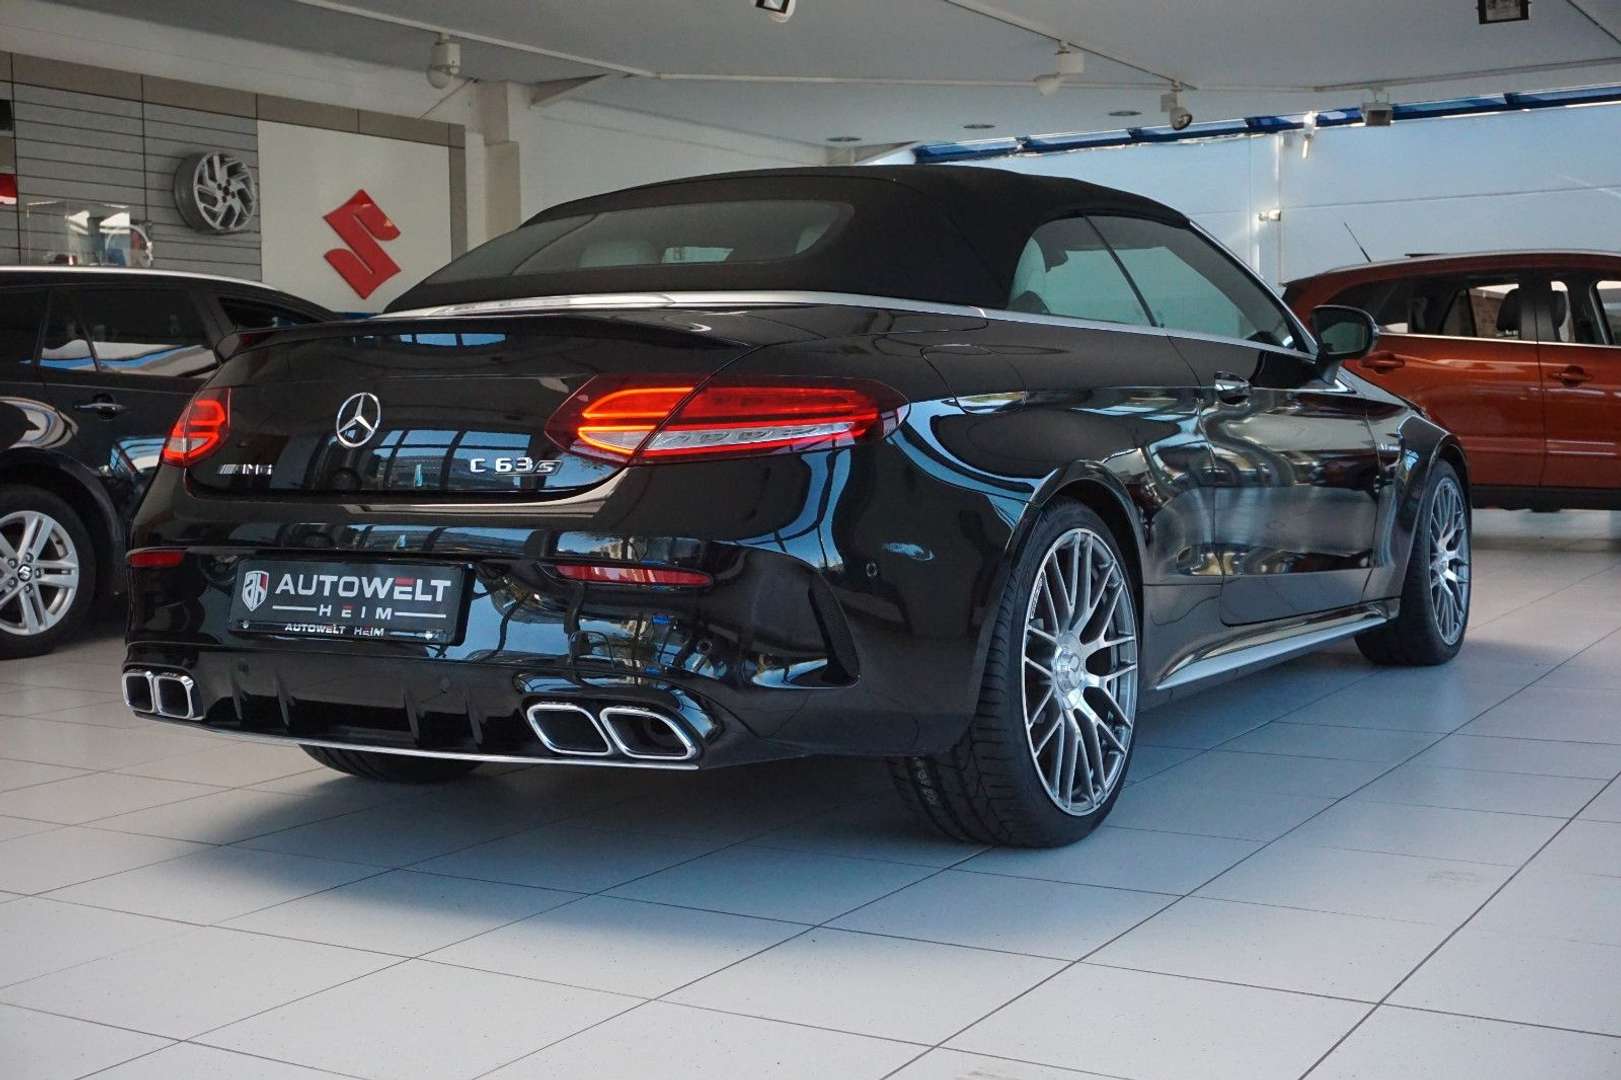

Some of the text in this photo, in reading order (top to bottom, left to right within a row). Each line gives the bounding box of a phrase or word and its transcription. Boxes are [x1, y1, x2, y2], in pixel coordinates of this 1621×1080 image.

[470, 458, 486, 473] C
[275, 573, 452, 602] AUTOWELT
[319, 604, 392, 620] HEIM
[285, 623, 385, 637] AUTOWELT HEIM
